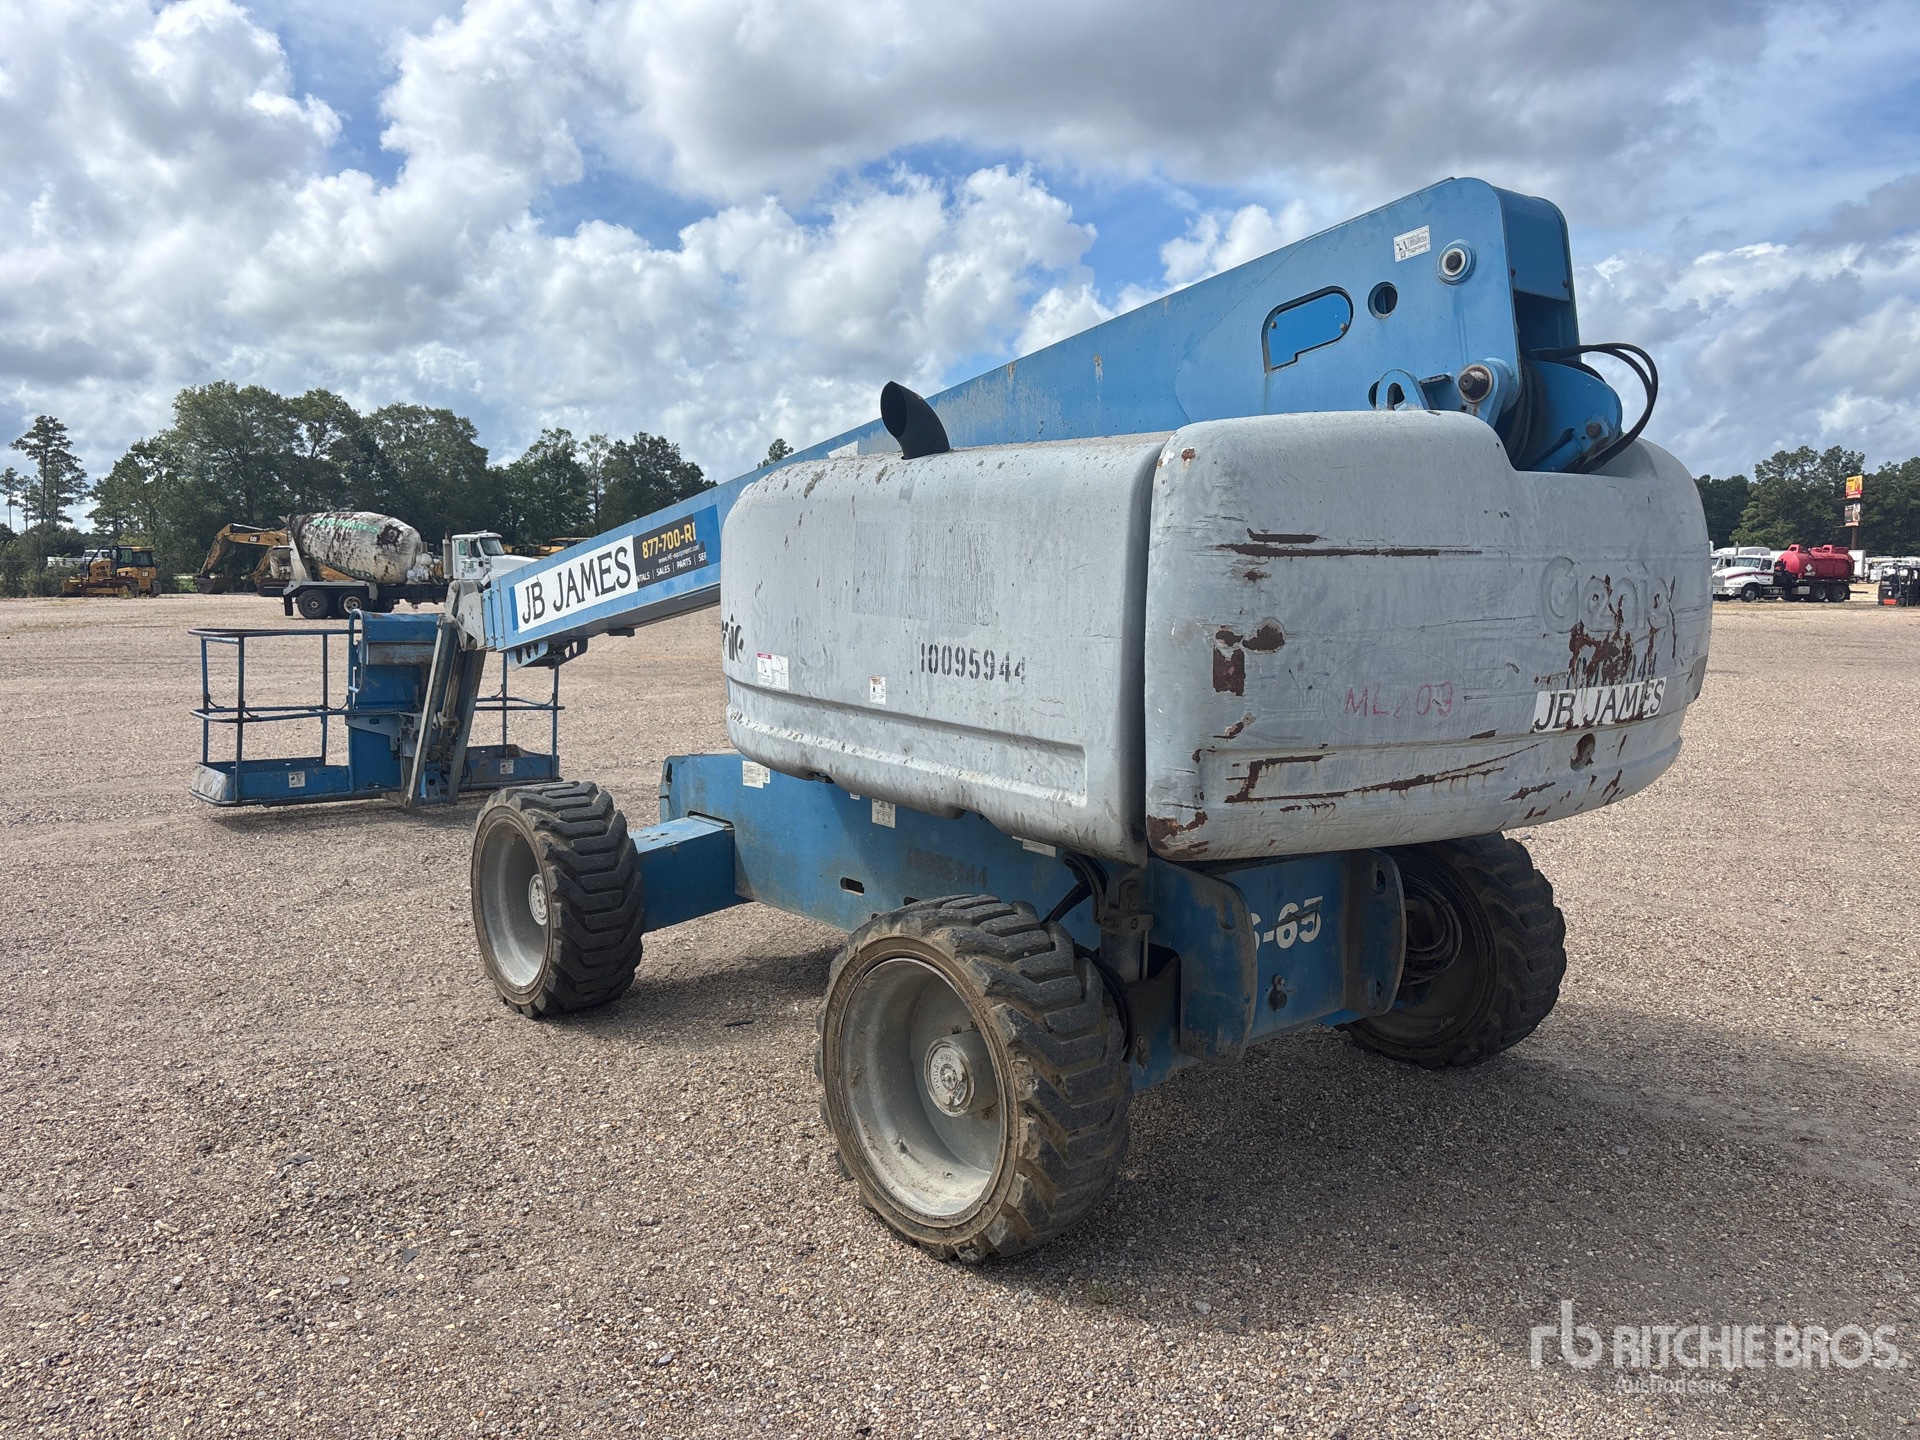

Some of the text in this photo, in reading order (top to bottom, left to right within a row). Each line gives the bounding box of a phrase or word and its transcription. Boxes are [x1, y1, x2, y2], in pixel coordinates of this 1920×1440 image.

[522, 546, 631, 624] JB JAMES
[656, 564, 671, 576] SALES
[676, 556, 692, 569] PARTS
[920, 643, 1026, 685] 10095944
[1534, 680, 1665, 731] JB JAMES
